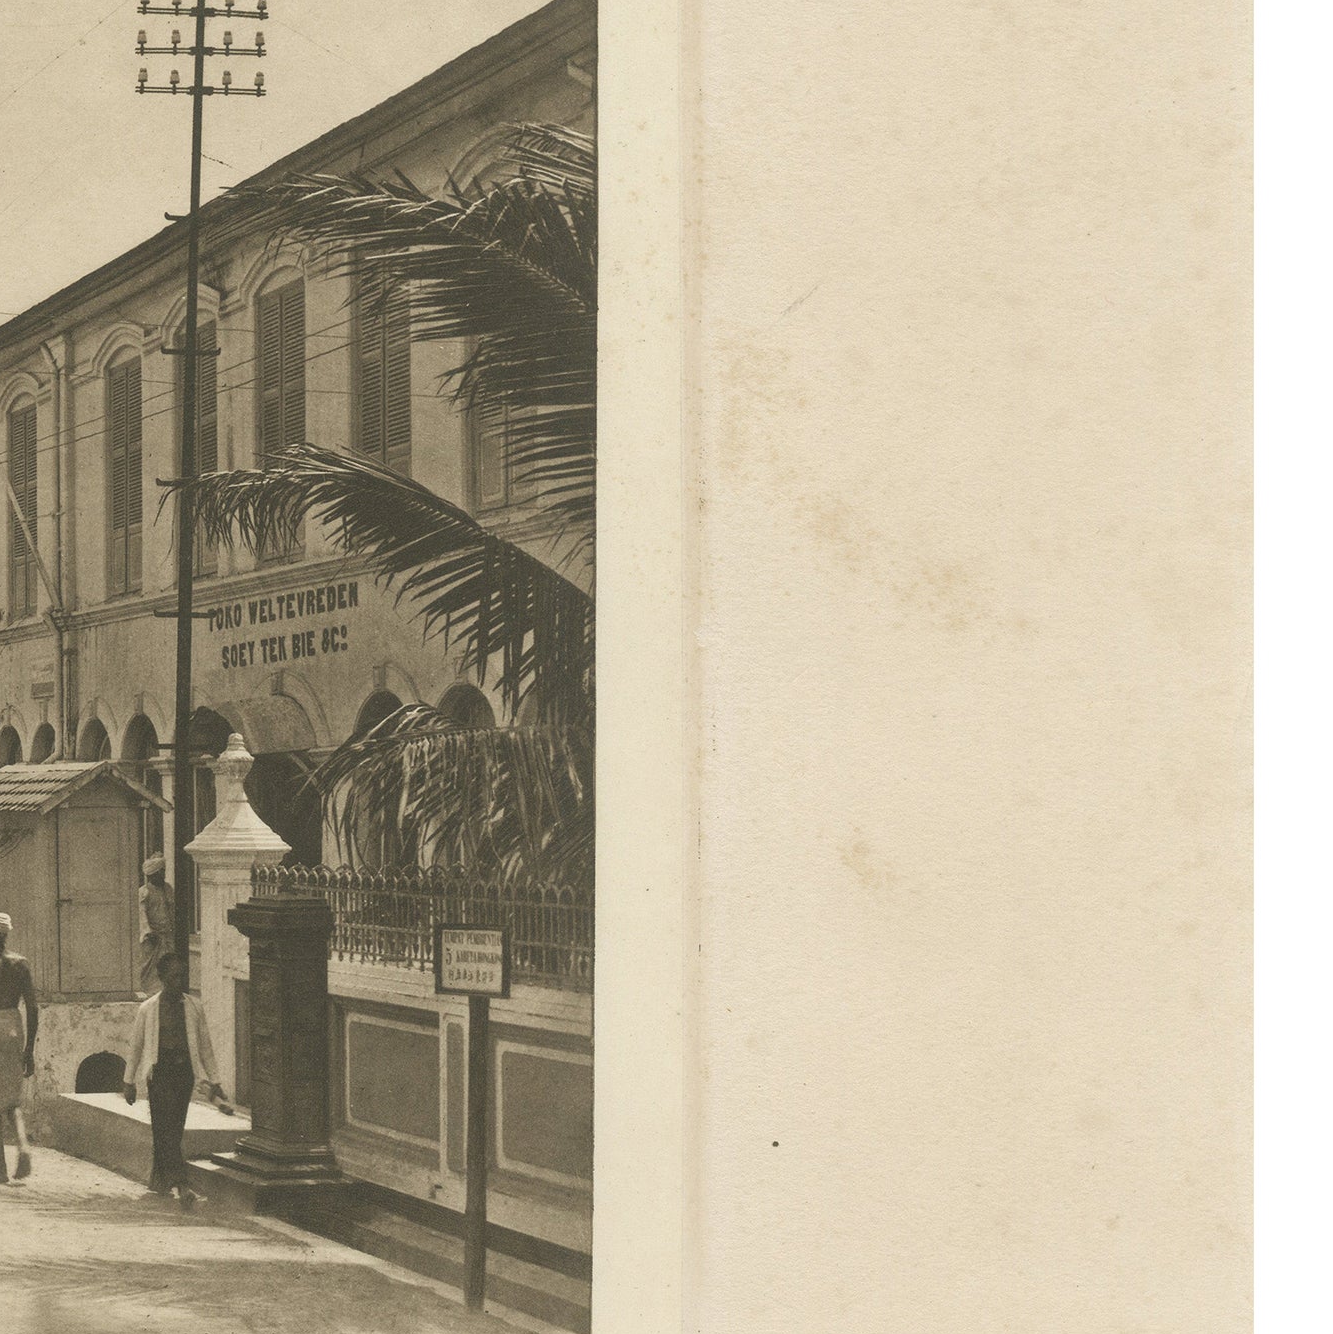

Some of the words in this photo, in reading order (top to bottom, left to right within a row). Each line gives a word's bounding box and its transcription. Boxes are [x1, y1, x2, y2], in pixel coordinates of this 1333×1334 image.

[208, 603, 242, 632] TOKO
[248, 581, 359, 625] WELTEVREDEN
[221, 640, 256, 669] SOEY
[260, 636, 288, 664] TEK
[291, 630, 316, 660] BIE
